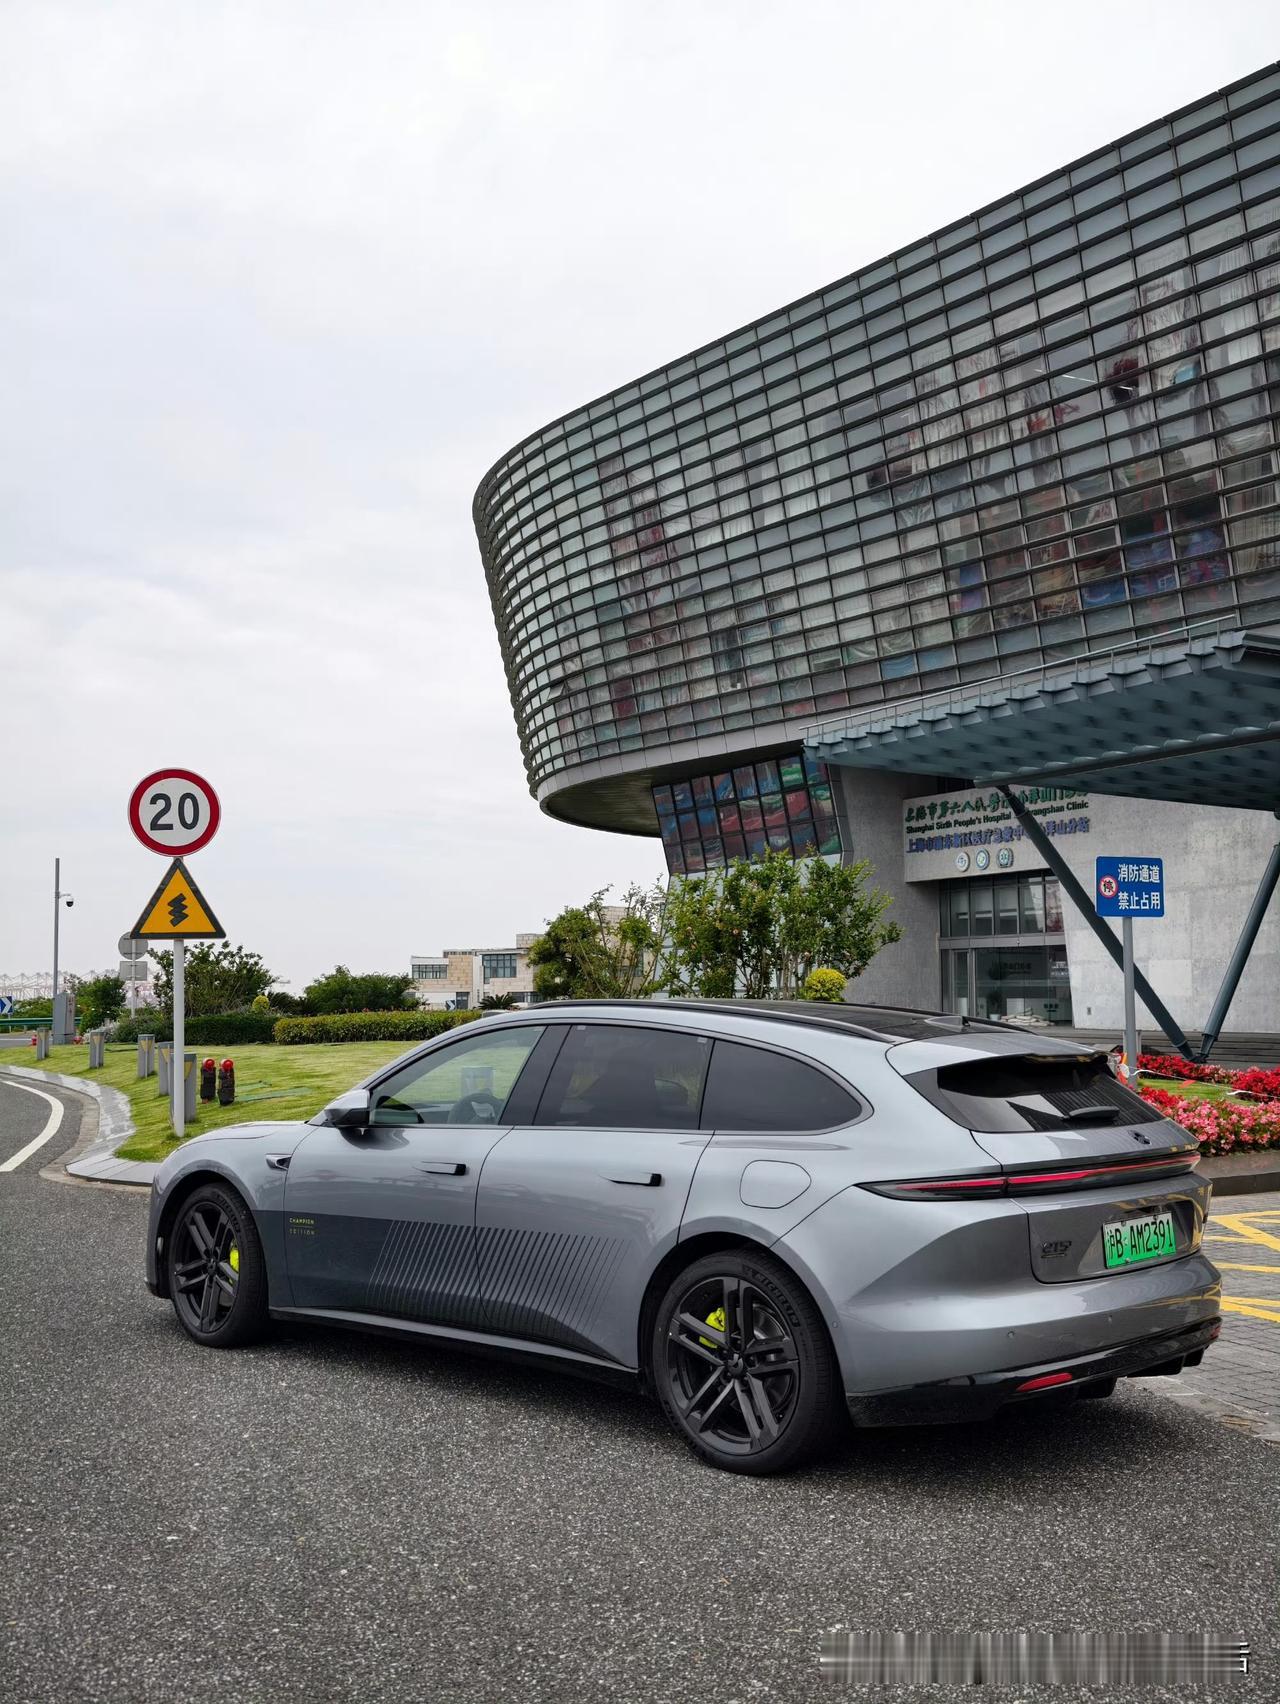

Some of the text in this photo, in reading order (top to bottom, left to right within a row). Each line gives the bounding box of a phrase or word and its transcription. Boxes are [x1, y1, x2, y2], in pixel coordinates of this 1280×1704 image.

[149, 792, 200, 831] 20
[906, 822, 934, 834] Shanghai
[936, 818, 952, 830] Sixth
[954, 816, 981, 828] People's
[983, 811, 1011, 824] Hospital
[1066, 800, 1089, 811] Clinic
[1118, 863, 1160, 883] 消防通道
[1118, 891, 1160, 910] 禁止占用
